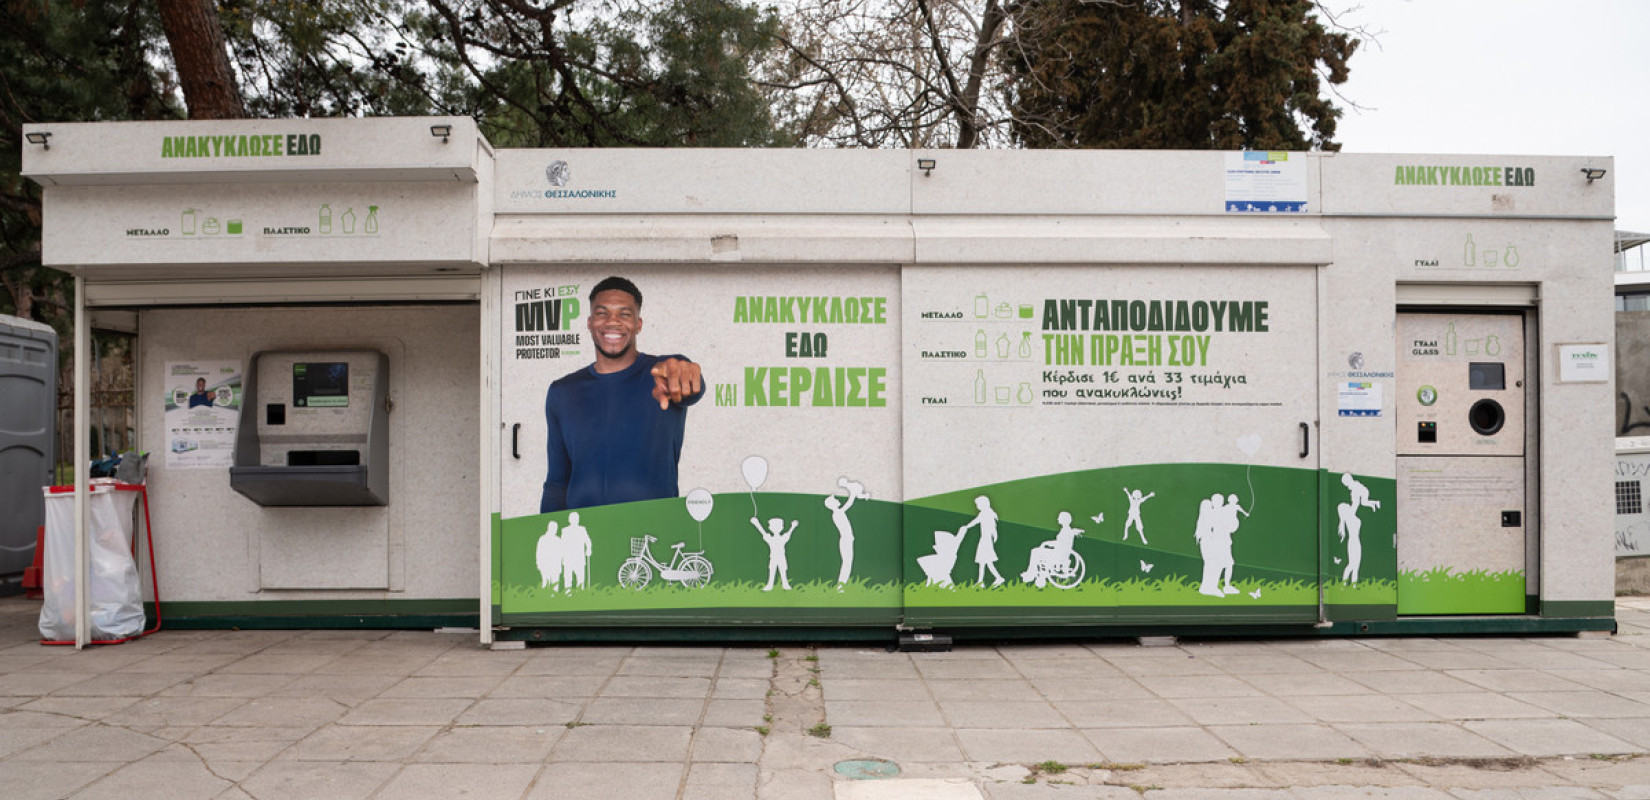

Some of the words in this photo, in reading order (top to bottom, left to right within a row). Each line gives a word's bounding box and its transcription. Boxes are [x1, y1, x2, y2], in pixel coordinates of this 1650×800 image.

[161, 134, 283, 158] ΑΝΑΚΥΚΛΩΣΕ
[286, 133, 321, 156] ΕΔΩ
[1394, 165, 1502, 186] ΑΝΑΚΥΚΛΩΣΕ
[1505, 167, 1535, 187] ΕΔΩ
[544, 190, 617, 198] ΘΕΣΣΑΛΟΝΙΚΗΣ
[126, 228, 170, 236] ΜΕΤΑΛΛΟ
[263, 226, 311, 235] ΠΛΑΣΤΙΚΟ
[515, 288, 541, 302] ΓΙΝΕ
[544, 287, 555, 298] ΚΙ
[558, 284, 580, 297] ΕΣΥ
[515, 297, 580, 332] MVP
[733, 296, 887, 324] ΑΝΑΚΥΚΛΩΣΕ
[921, 311, 963, 319] ΜΕΤΑΛΛΟ
[1041, 298, 1269, 333] ΑΝΤΑΠΟΔΙΔΟΥΜΕ
[516, 334, 539, 346] MOST
[541, 333, 580, 345] VALUABLE
[785, 332, 828, 358] ΕΔΩ
[516, 347, 560, 359] PROTECTOR
[1042, 333, 1084, 366] ΤΗΝ
[1091, 334, 1162, 366] ΠΡΑΞΗ
[1168, 334, 1211, 367] ΣΟΥ
[715, 383, 737, 407] ΚΑΙ
[744, 366, 887, 407] ΚΕΡΔΙΣΕ
[1042, 371, 1095, 385] Κέρδισε
[1103, 371, 1120, 383] 1€
[1128, 371, 1156, 384] ανά
[1164, 371, 1183, 383] 33
[1190, 371, 1247, 389] τεμάχια
[1042, 388, 1068, 399] που
[1076, 386, 1182, 401] ανακυκλώνεις!
